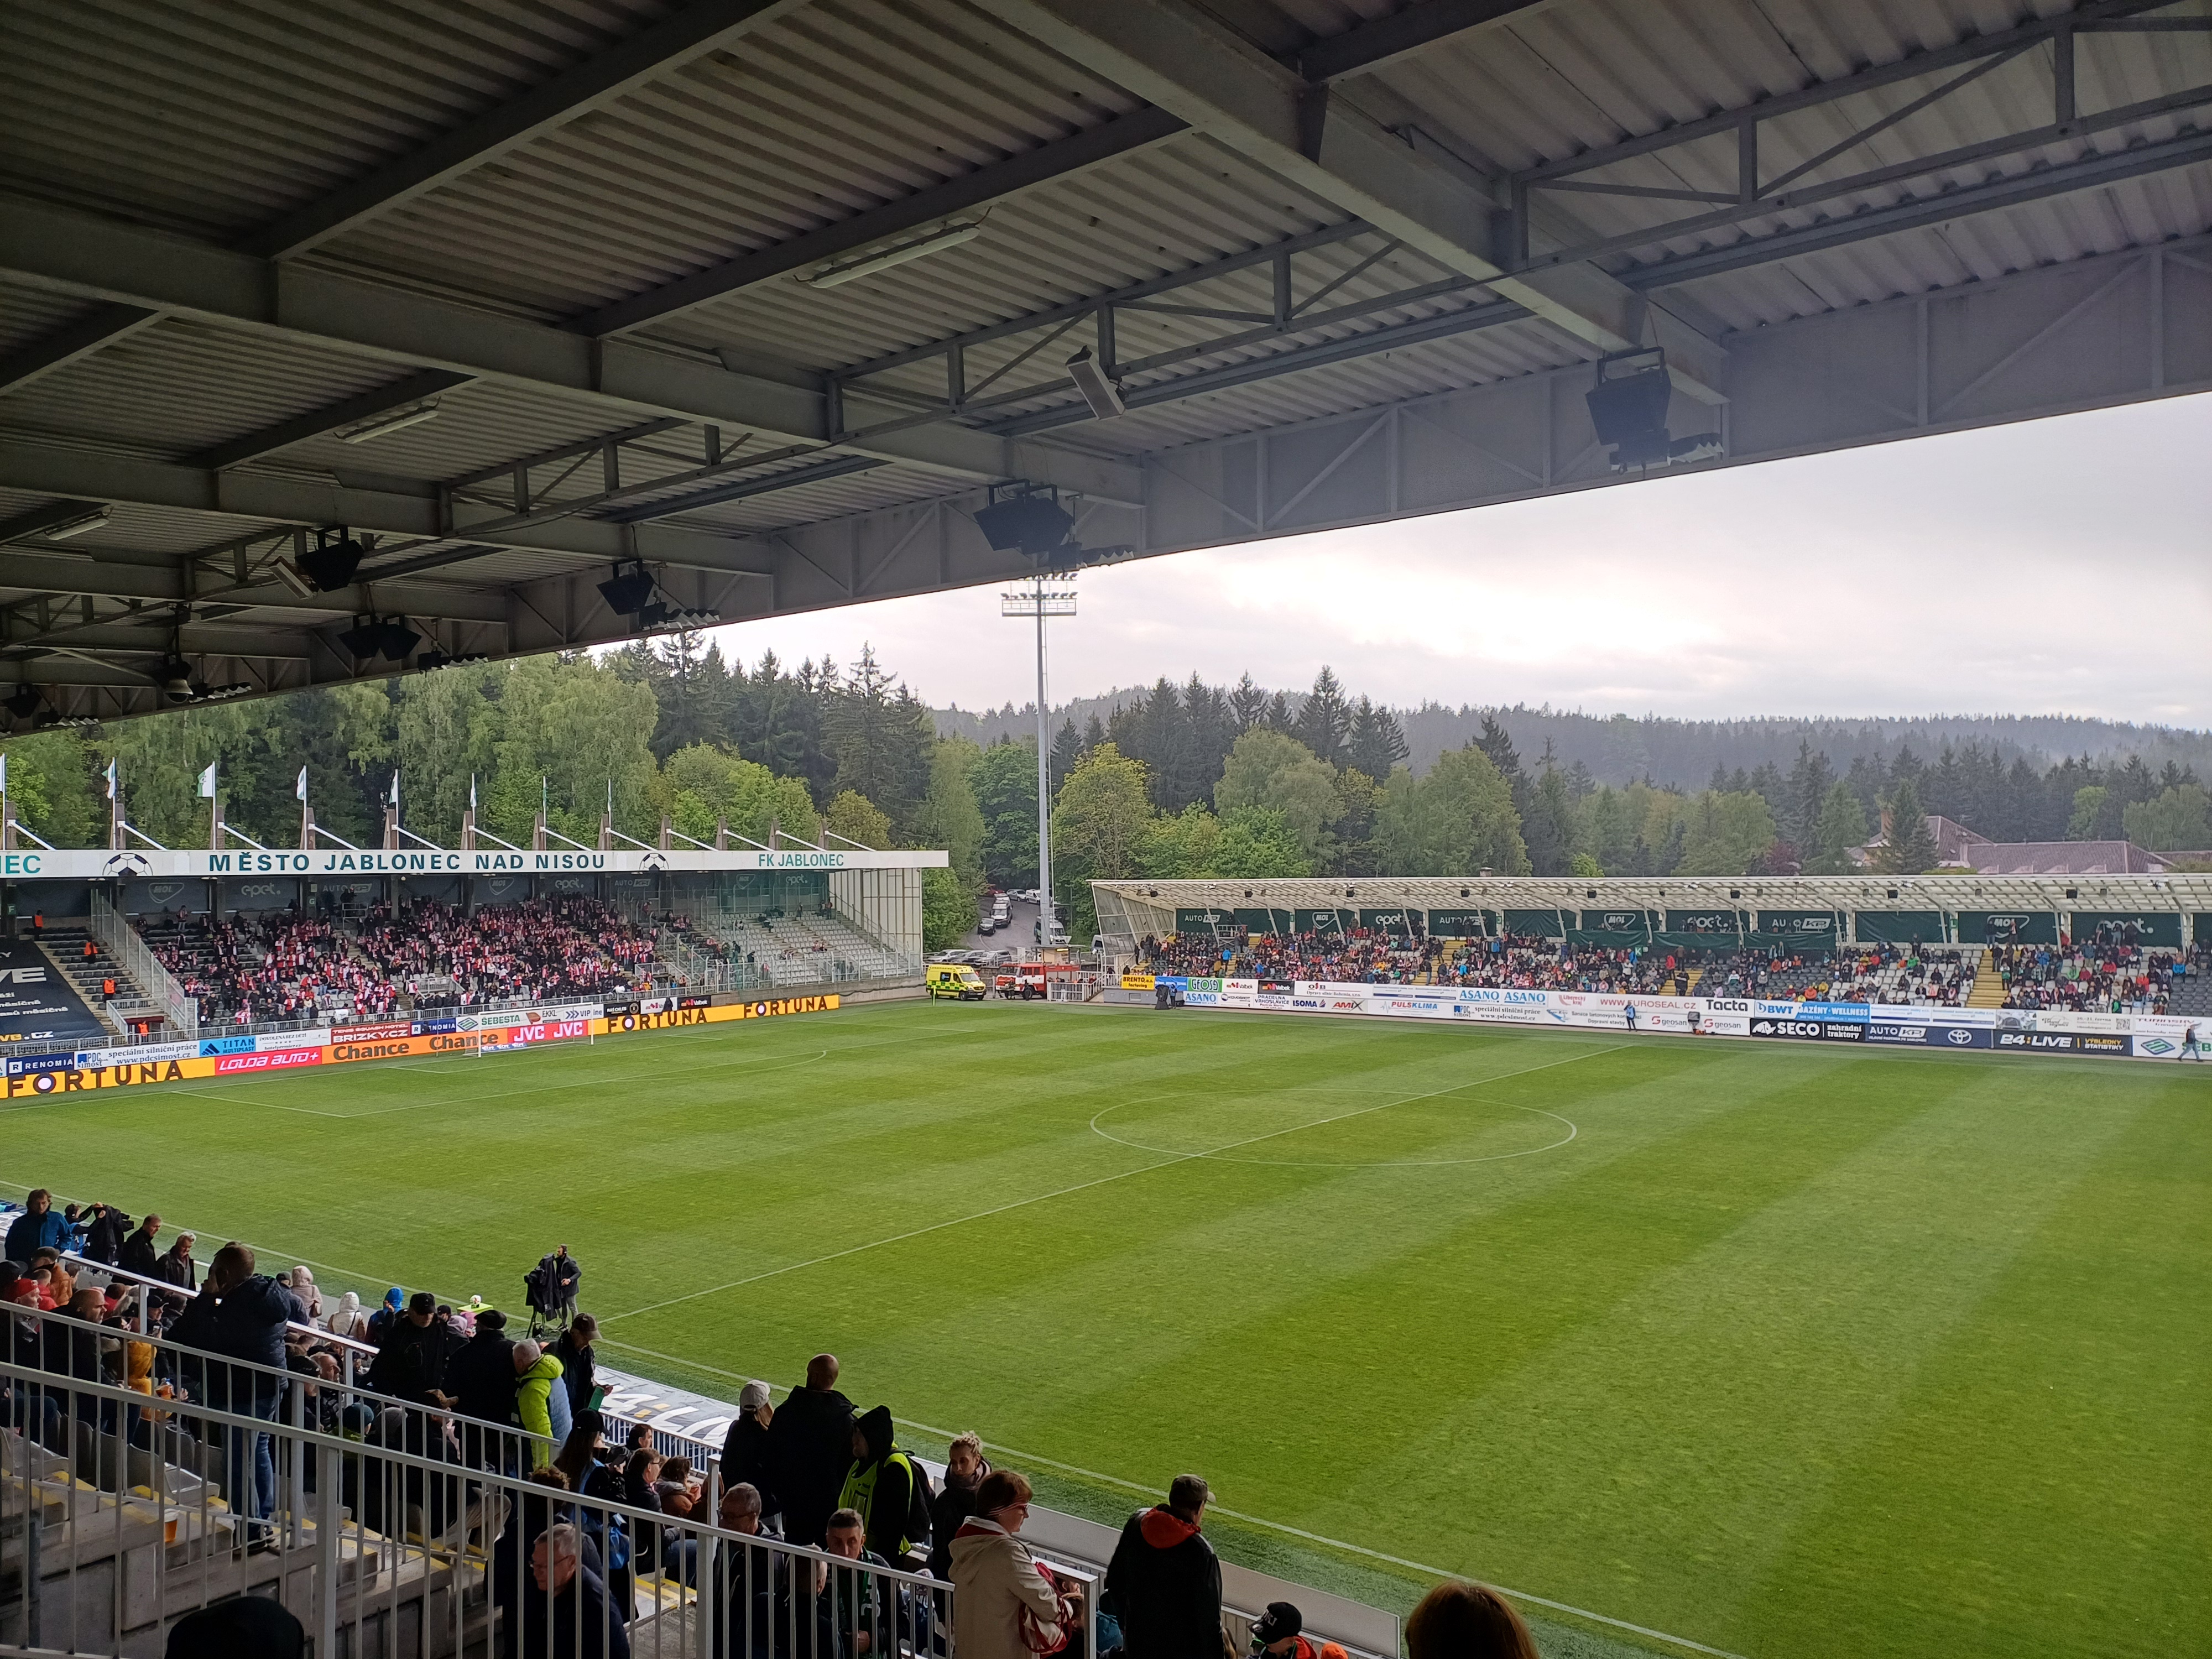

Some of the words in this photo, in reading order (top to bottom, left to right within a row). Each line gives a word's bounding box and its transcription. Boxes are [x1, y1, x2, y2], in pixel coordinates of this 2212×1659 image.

[210, 852, 309, 872] MĚSTO
[325, 854, 460, 870] JABLONEC
[476, 854, 523, 870] NAD
[535, 854, 604, 870] NISOU
[758, 854, 775, 867] FK
[778, 854, 844, 867] JABLONEC
[1635, 947, 1641, 955] K
[1185, 993, 1217, 1003] ASANO
[1459, 990, 1500, 1000] ASANO
[1504, 992, 1546, 1003] ASANO
[744, 996, 828, 1018] FORTUNA
[1332, 999, 1365, 1012] AMIX
[1391, 1001, 1438, 1010] PULSKLIMA
[1572, 998, 1583, 1006] kraj
[1706, 999, 1749, 1011] Tacta
[1475, 1006, 1501, 1015] speciální
[1767, 1005, 1793, 1014] BWT
[1831, 1007, 1868, 1016] WELLNESS
[481, 1014, 520, 1026] ŠEBESTA
[608, 1008, 707, 1033] FORTUNA
[1662, 1019, 1687, 1027] geosan
[1715, 1021, 1741, 1030] geosan
[514, 1026, 545, 1042] JVC
[554, 1021, 583, 1038] JVC
[1777, 1021, 1820, 1037] SECO
[1827, 1024, 1863, 1033] zahradní
[1870, 1026, 1898, 1036] AUTO
[1827, 1030, 1860, 1040] traktory
[222, 1038, 254, 1048] TITAN
[430, 1034, 498, 1050] Chance
[2000, 1034, 2073, 1048] 24:LIVE
[2085, 1036, 2122, 1046] VÝSLEDKY
[108, 1047, 144, 1059] speciální
[145, 1045, 175, 1054] silniční
[176, 1043, 197, 1053] práce
[333, 1043, 409, 1061] Chance
[2084, 1043, 2124, 1051] STATISTIKY
[87, 1052, 101, 1063] PDC
[25, 1058, 74, 1070] RENOMIA
[9, 1060, 184, 1098] FORTUNA
